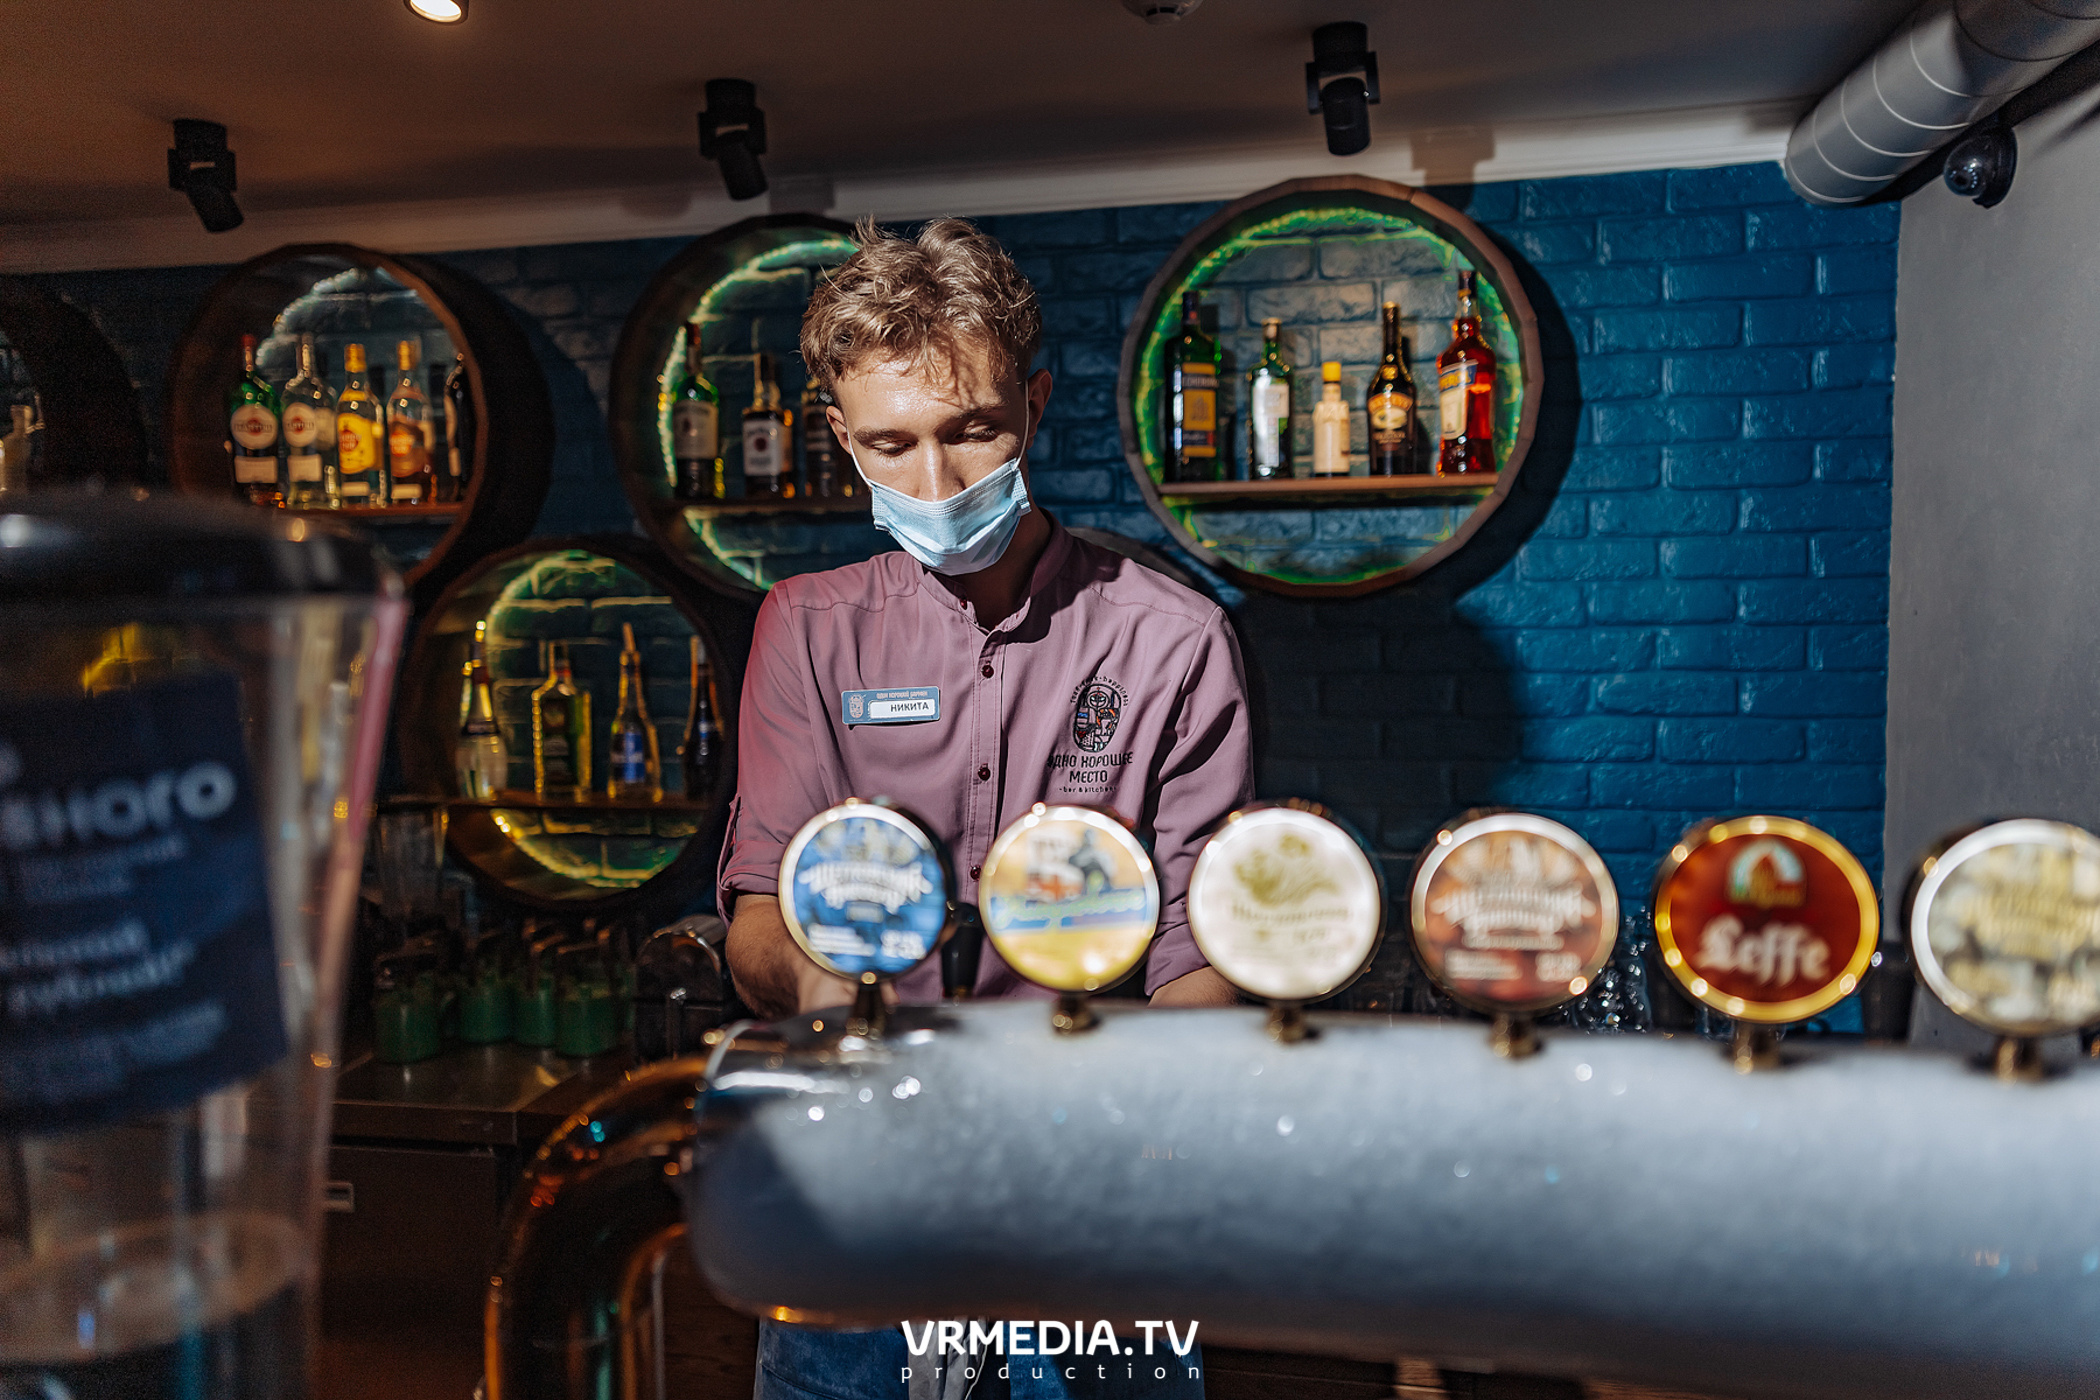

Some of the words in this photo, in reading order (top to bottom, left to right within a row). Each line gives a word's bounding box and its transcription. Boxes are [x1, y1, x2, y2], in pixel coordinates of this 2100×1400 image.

[890, 702, 929, 712] НИКИТА
[1069, 770, 1108, 783] МЕСТО
[1694, 913, 1830, 987] Leffe
